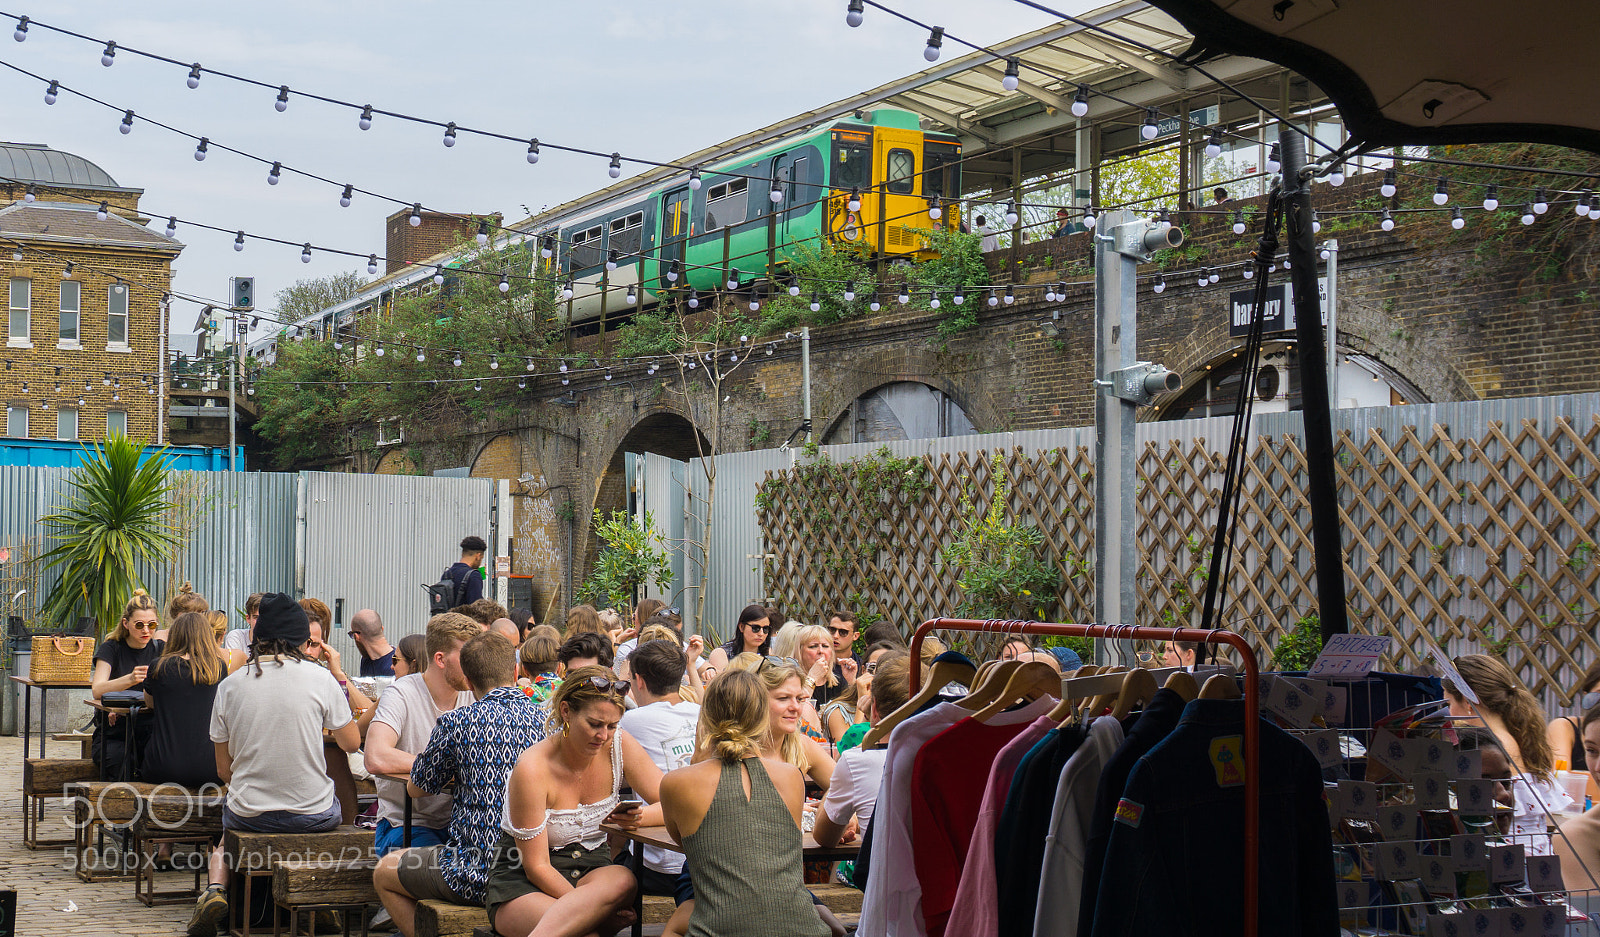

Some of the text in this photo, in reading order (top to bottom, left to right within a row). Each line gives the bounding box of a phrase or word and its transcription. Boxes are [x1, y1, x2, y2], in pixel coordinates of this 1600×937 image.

[1158, 120, 1180, 134] Peckha
[1233, 299, 1281, 327] barory
[1326, 636, 1390, 654] PATCHES
